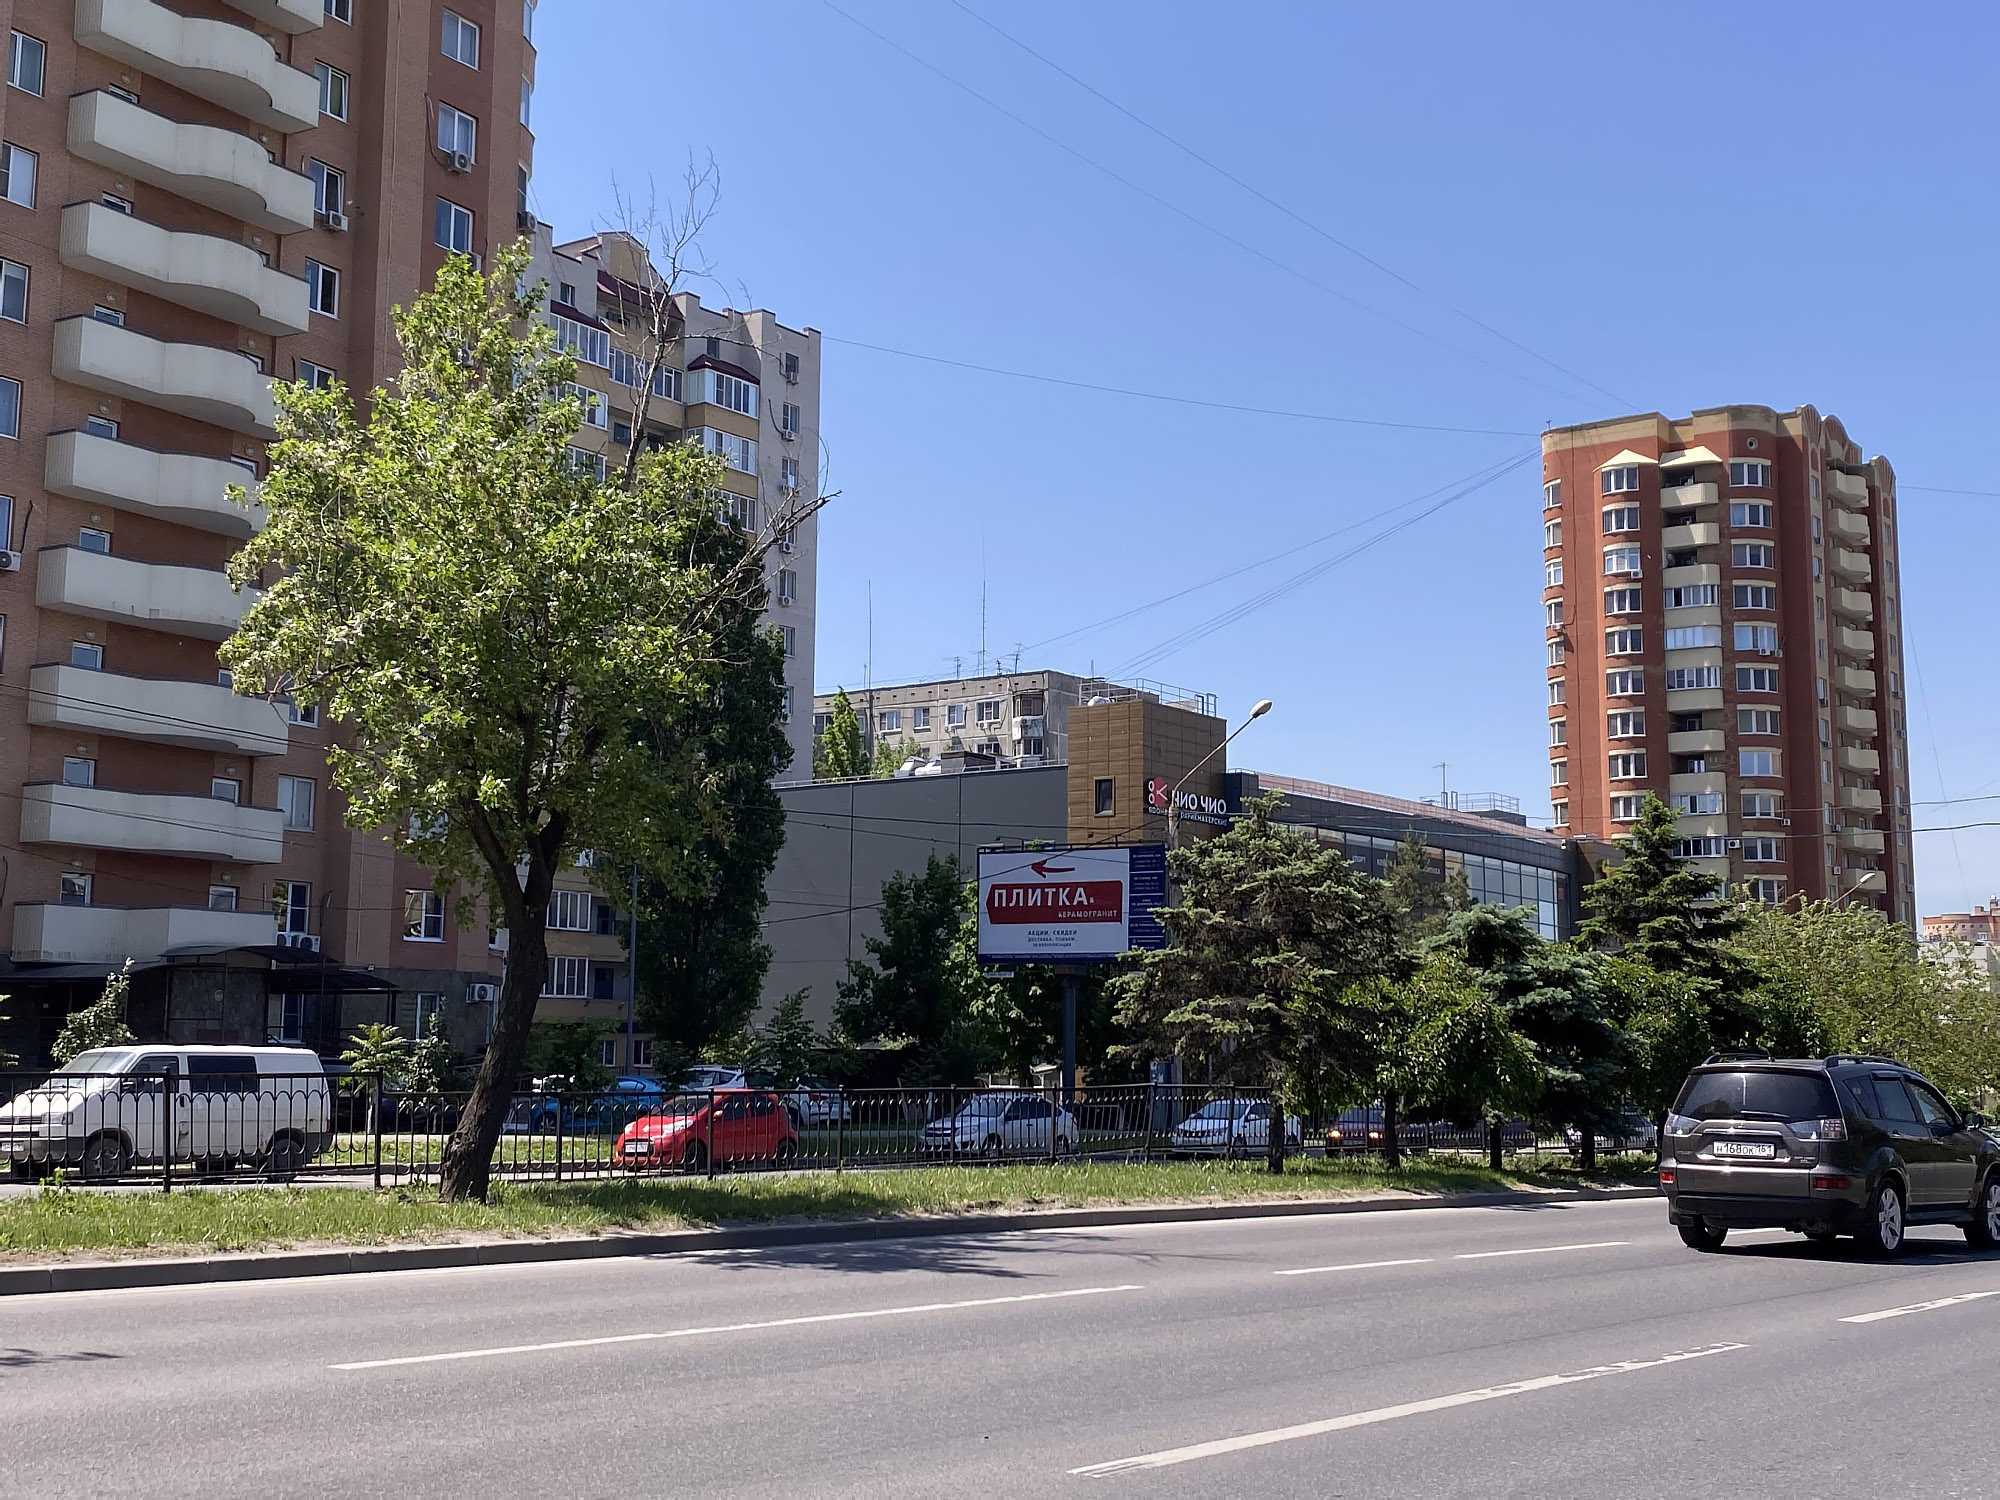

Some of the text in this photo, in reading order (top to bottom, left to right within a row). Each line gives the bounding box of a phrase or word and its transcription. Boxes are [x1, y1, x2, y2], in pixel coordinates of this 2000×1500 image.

[1200, 795, 1227, 815] ЧИО
[995, 887, 1088, 907] ПЛИТКА
[1058, 910, 1118, 918] КЕРАМОГРАНИТ
